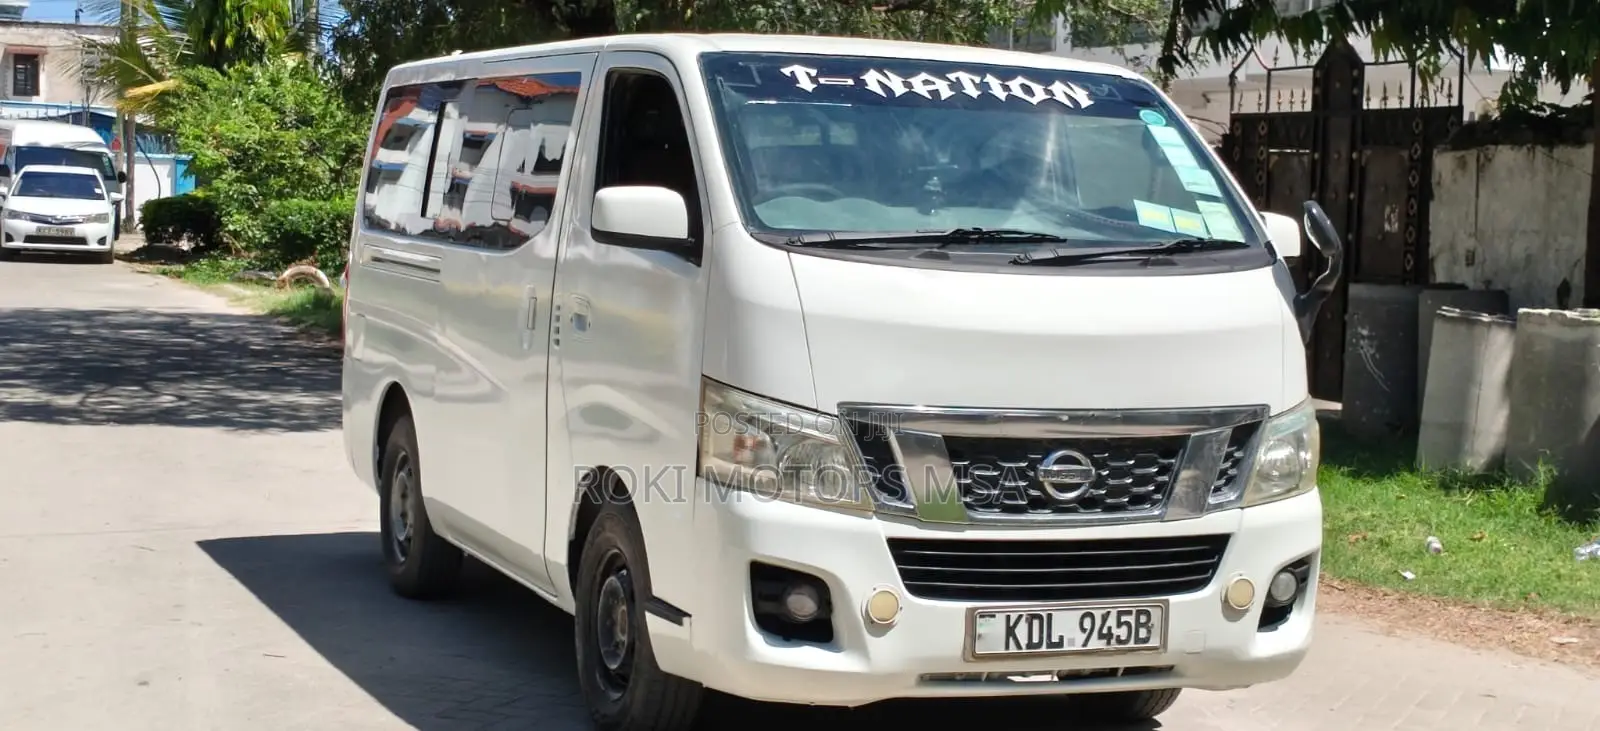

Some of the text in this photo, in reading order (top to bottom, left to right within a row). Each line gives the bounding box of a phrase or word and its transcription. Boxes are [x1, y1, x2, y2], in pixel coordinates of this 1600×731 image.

[780, 64, 1094, 109] T-NATION
[1005, 608, 1152, 651] KDL 945B
